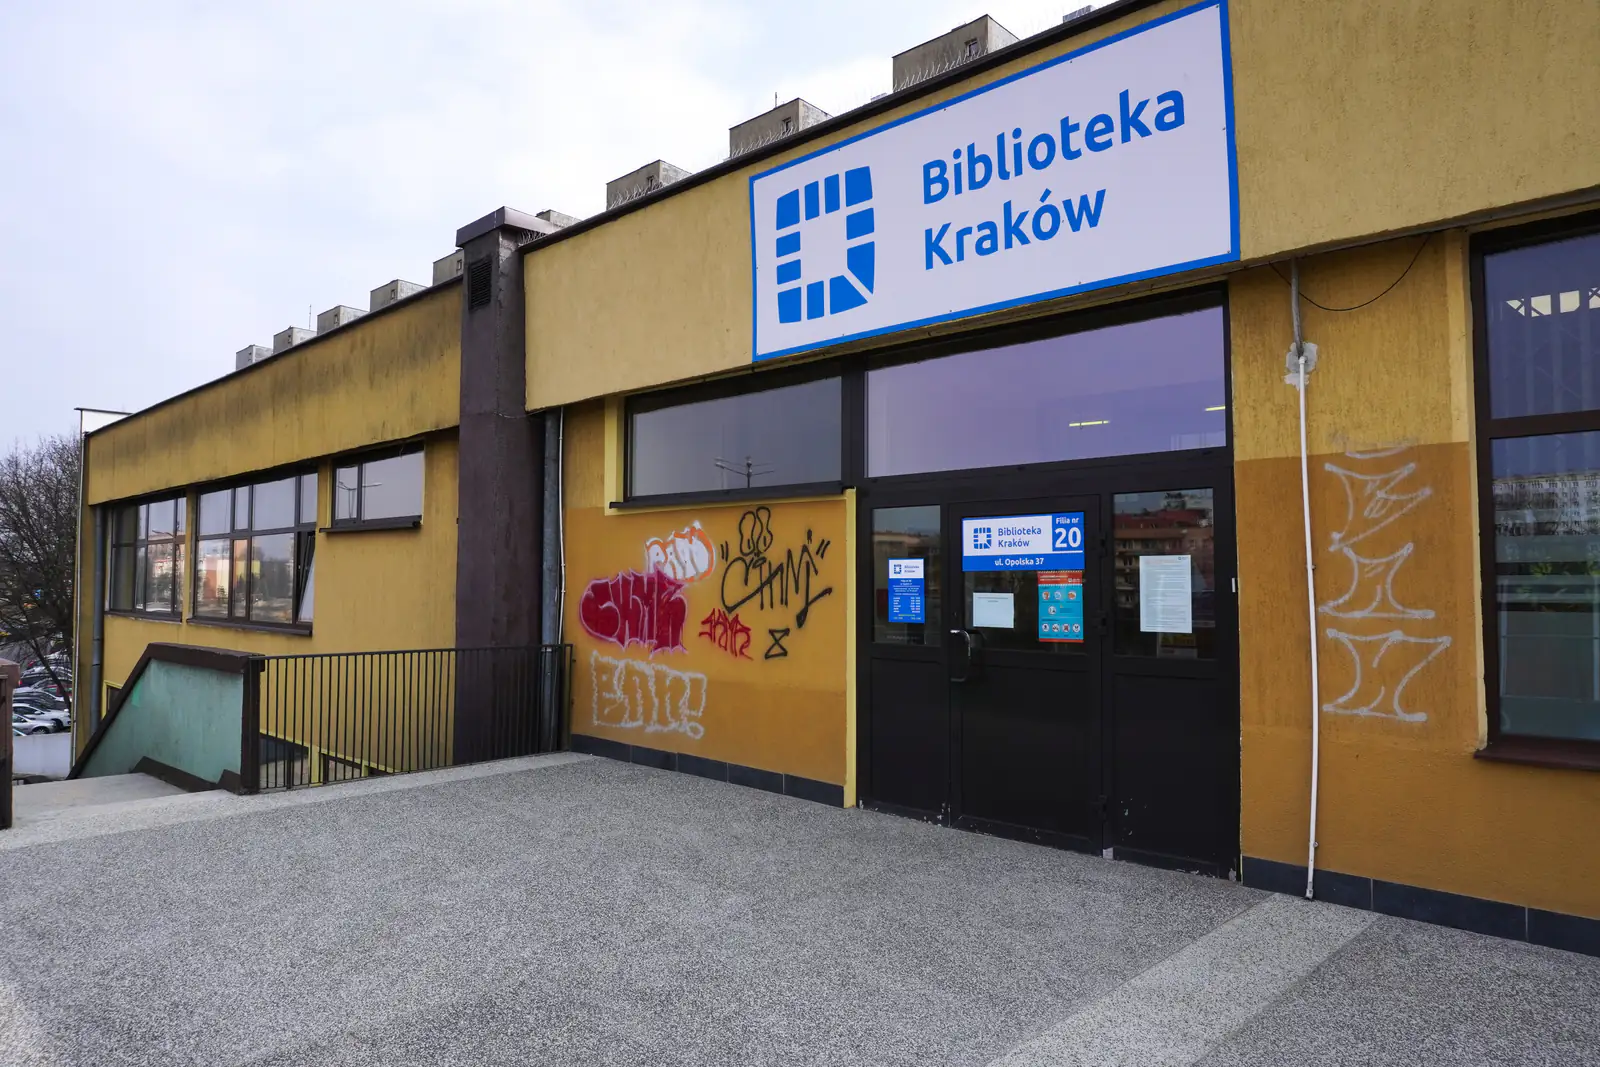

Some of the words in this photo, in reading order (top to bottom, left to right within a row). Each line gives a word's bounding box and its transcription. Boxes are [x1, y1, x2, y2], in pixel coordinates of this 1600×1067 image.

[922, 88, 1186, 205] Biblioteka
[924, 188, 1107, 270] Kraków
[998, 526, 1042, 536] Biblioteka
[1054, 527, 1082, 548] 20
[998, 538, 1030, 548] Kraków
[994, 558, 1004, 566] ul.
[1004, 558, 1034, 567] Opolska
[1035, 557, 1045, 565] 37
